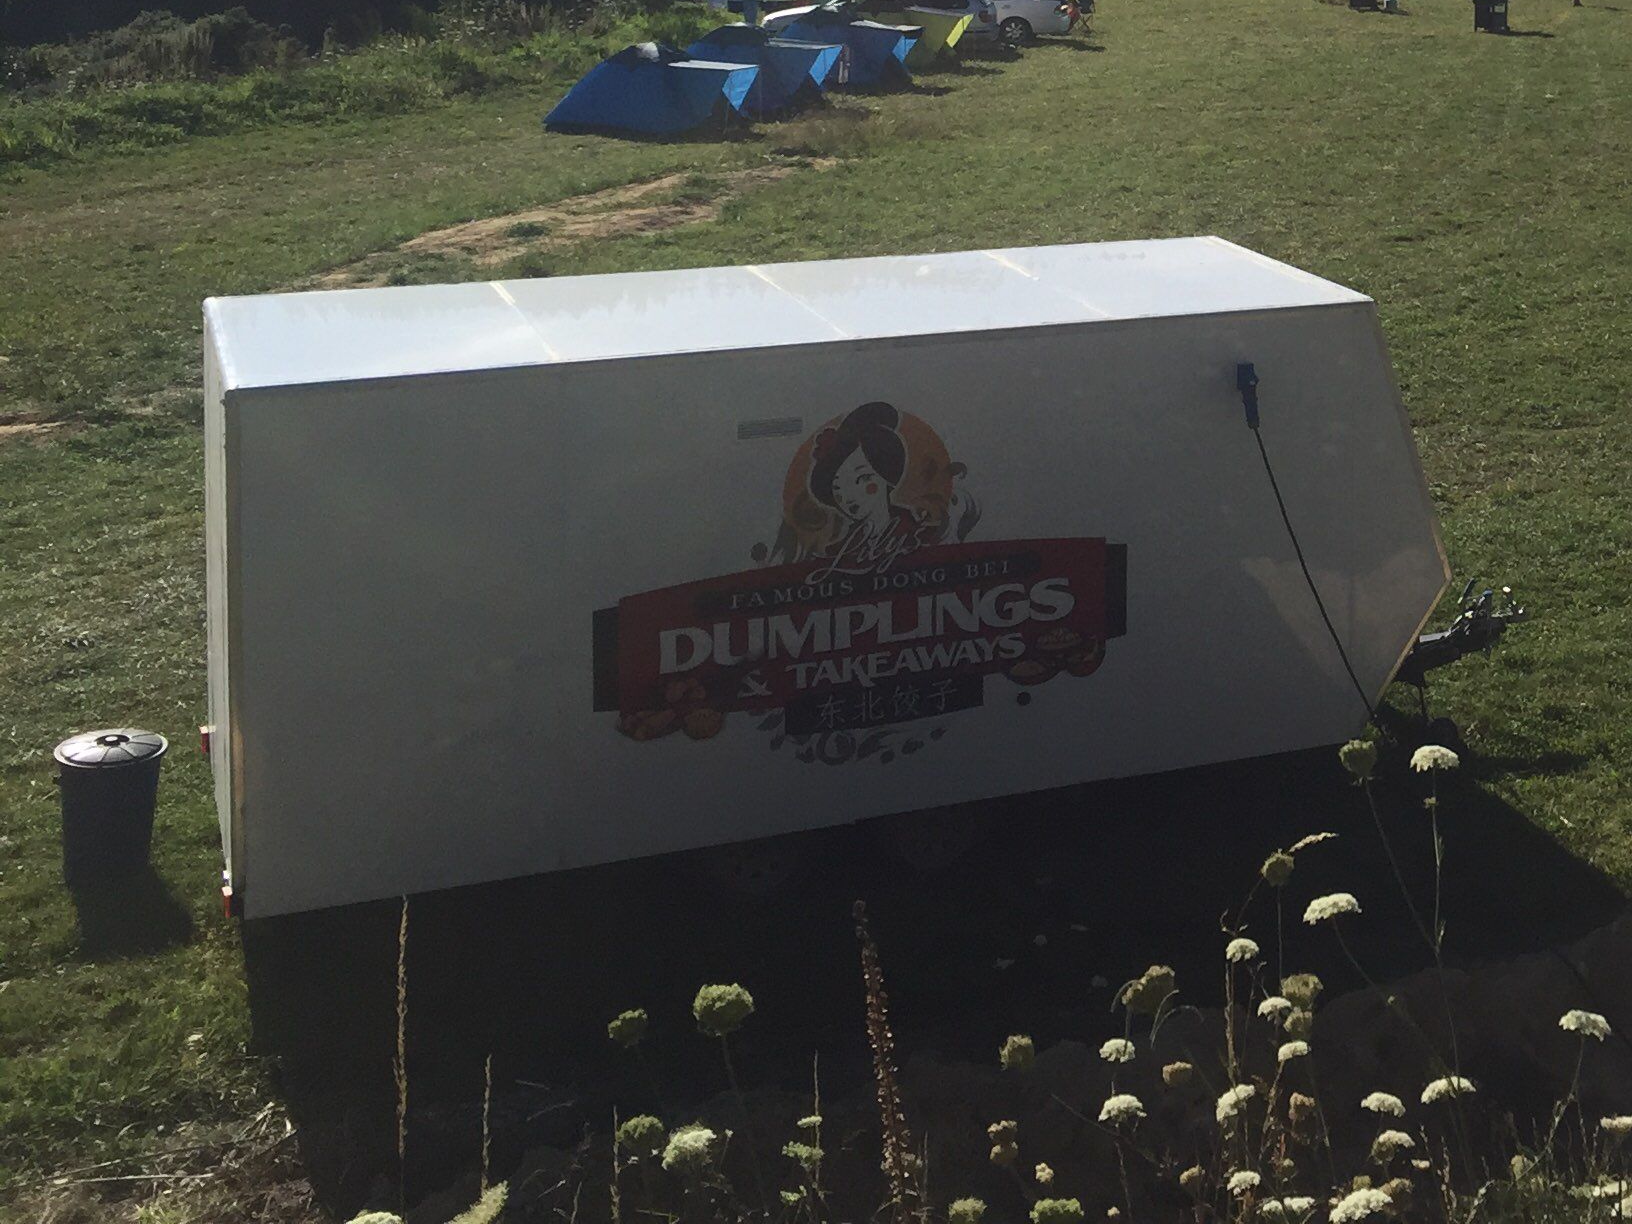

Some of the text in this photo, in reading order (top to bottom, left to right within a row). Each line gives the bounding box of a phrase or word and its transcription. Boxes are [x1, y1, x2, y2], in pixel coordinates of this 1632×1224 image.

[729, 559, 1009, 610] FAMOUS DONG BEI
[658, 577, 1076, 675] DUMPLINGS
[736, 632, 1027, 699] & TAKEAWAYS
[815, 679, 959, 729] 东北饺子
